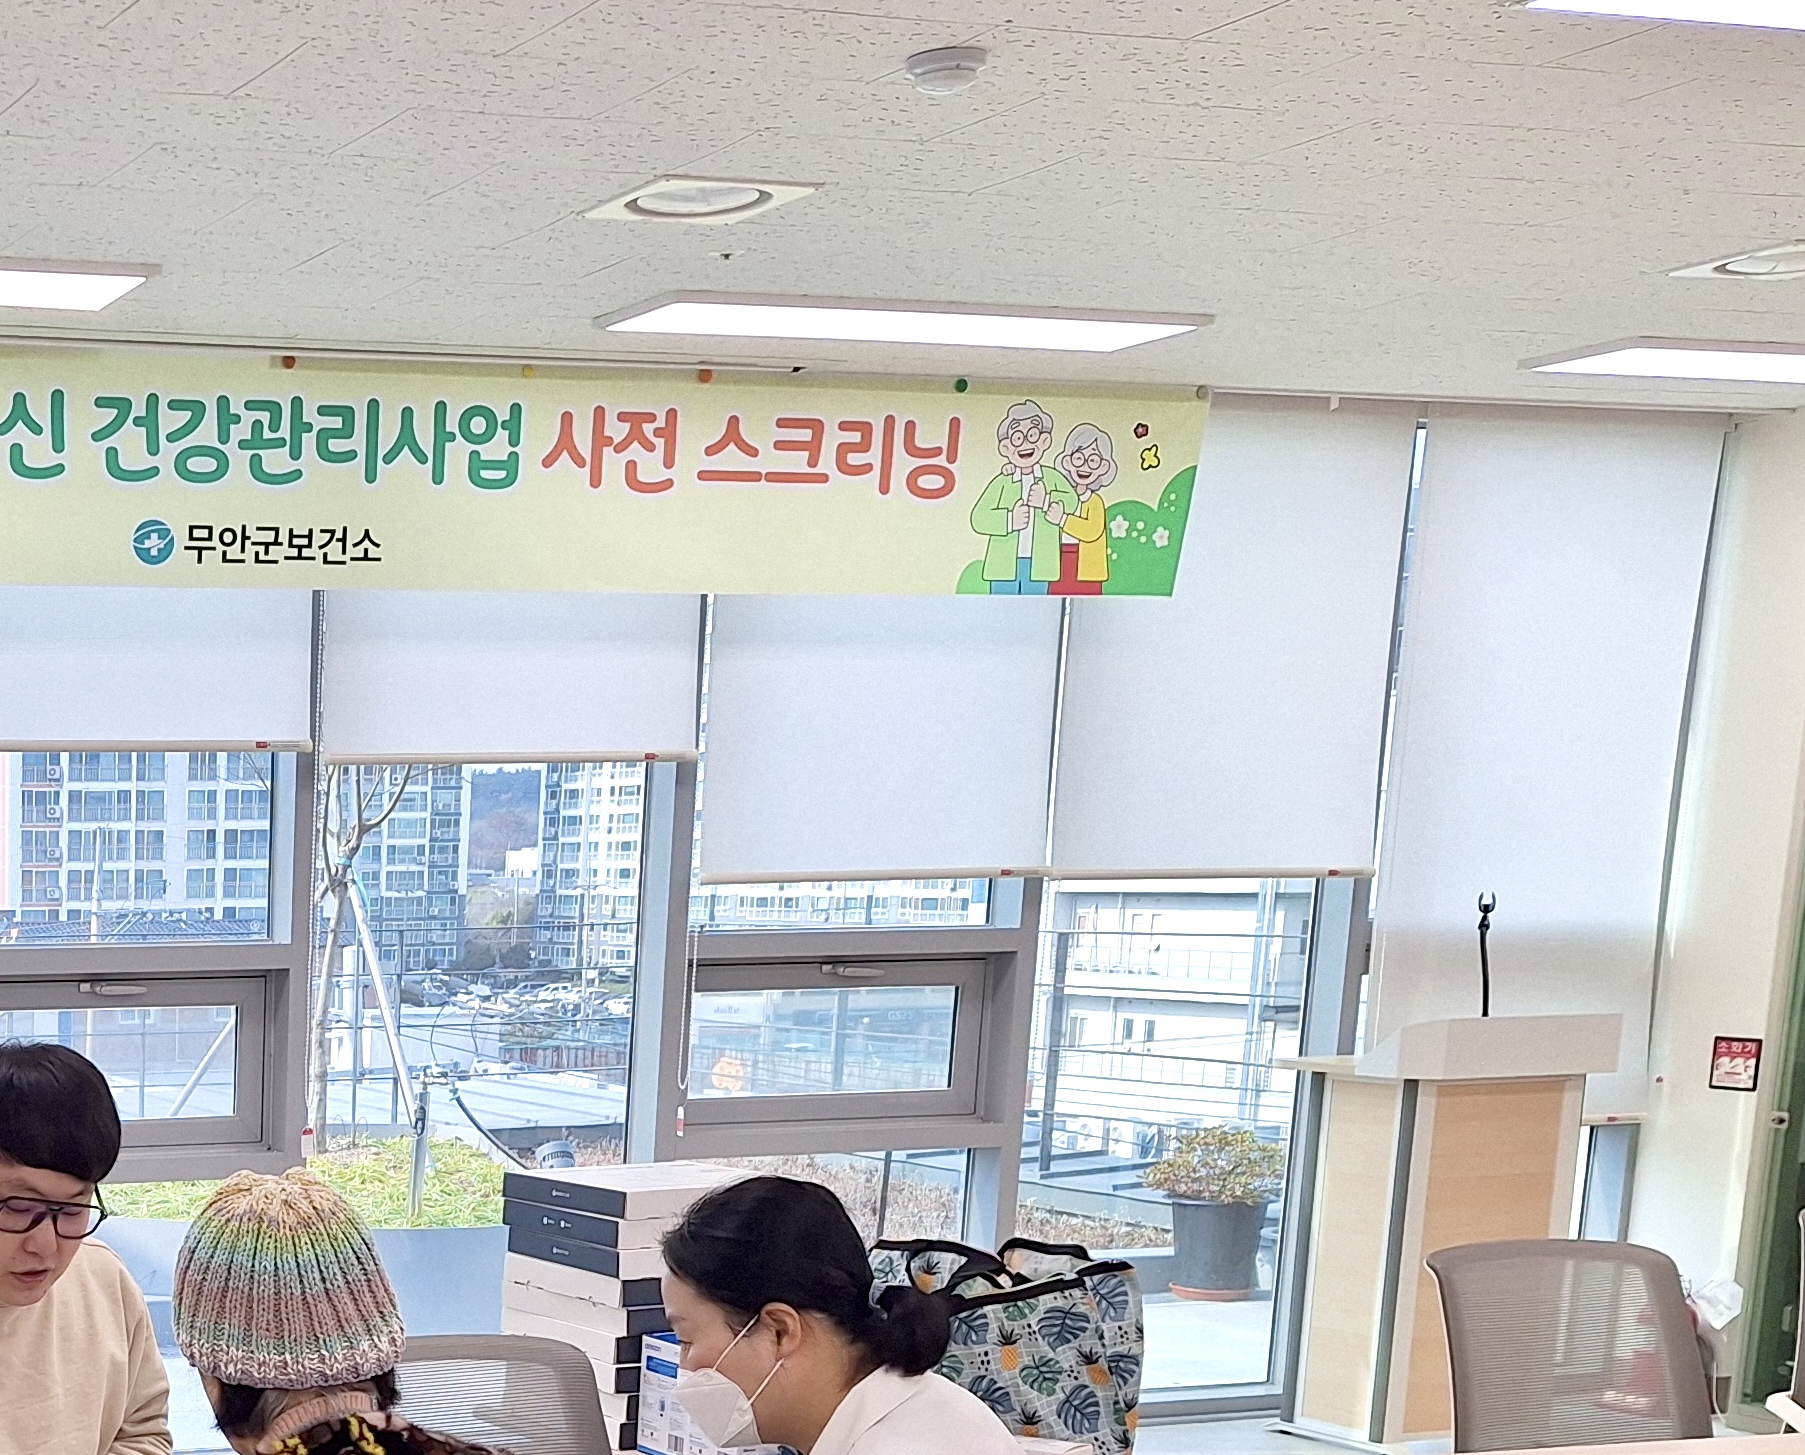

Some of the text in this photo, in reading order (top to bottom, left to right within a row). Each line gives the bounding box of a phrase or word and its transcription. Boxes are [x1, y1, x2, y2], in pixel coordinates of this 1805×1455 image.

[90, 393, 524, 491] 건강관리사업
[541, 405, 680, 495] 사전
[696, 413, 963, 502] 스크리닝
[182, 523, 384, 567] 무안군보건소
[1717, 1041, 1756, 1054] 소화기
